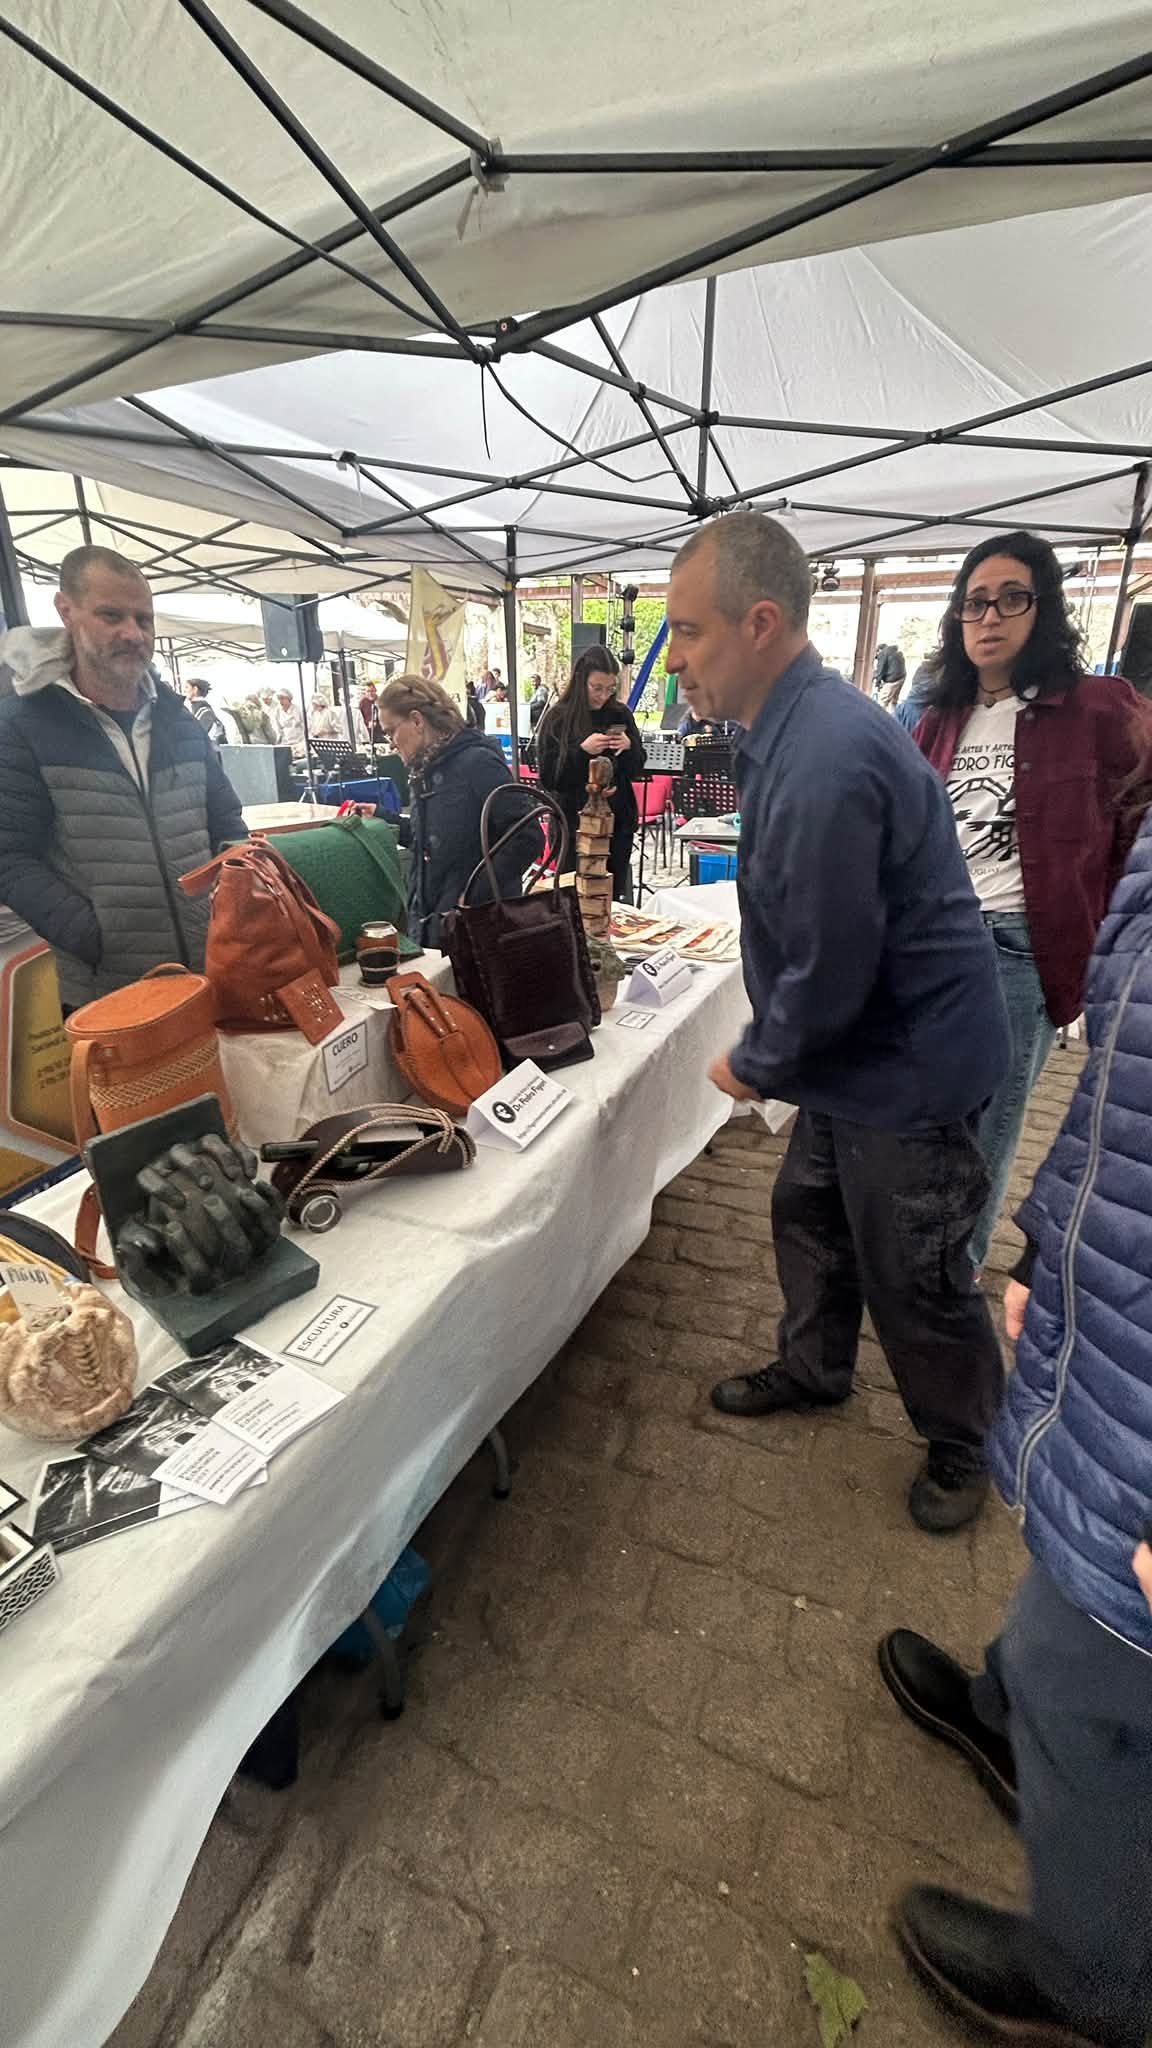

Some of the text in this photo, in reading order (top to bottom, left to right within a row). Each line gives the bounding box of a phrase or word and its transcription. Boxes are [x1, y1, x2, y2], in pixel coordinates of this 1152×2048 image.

[985, 744, 991, 752] Y
[333, 1032, 358, 1056] CUERO
[297, 1305, 348, 1351] ESCULTURA
